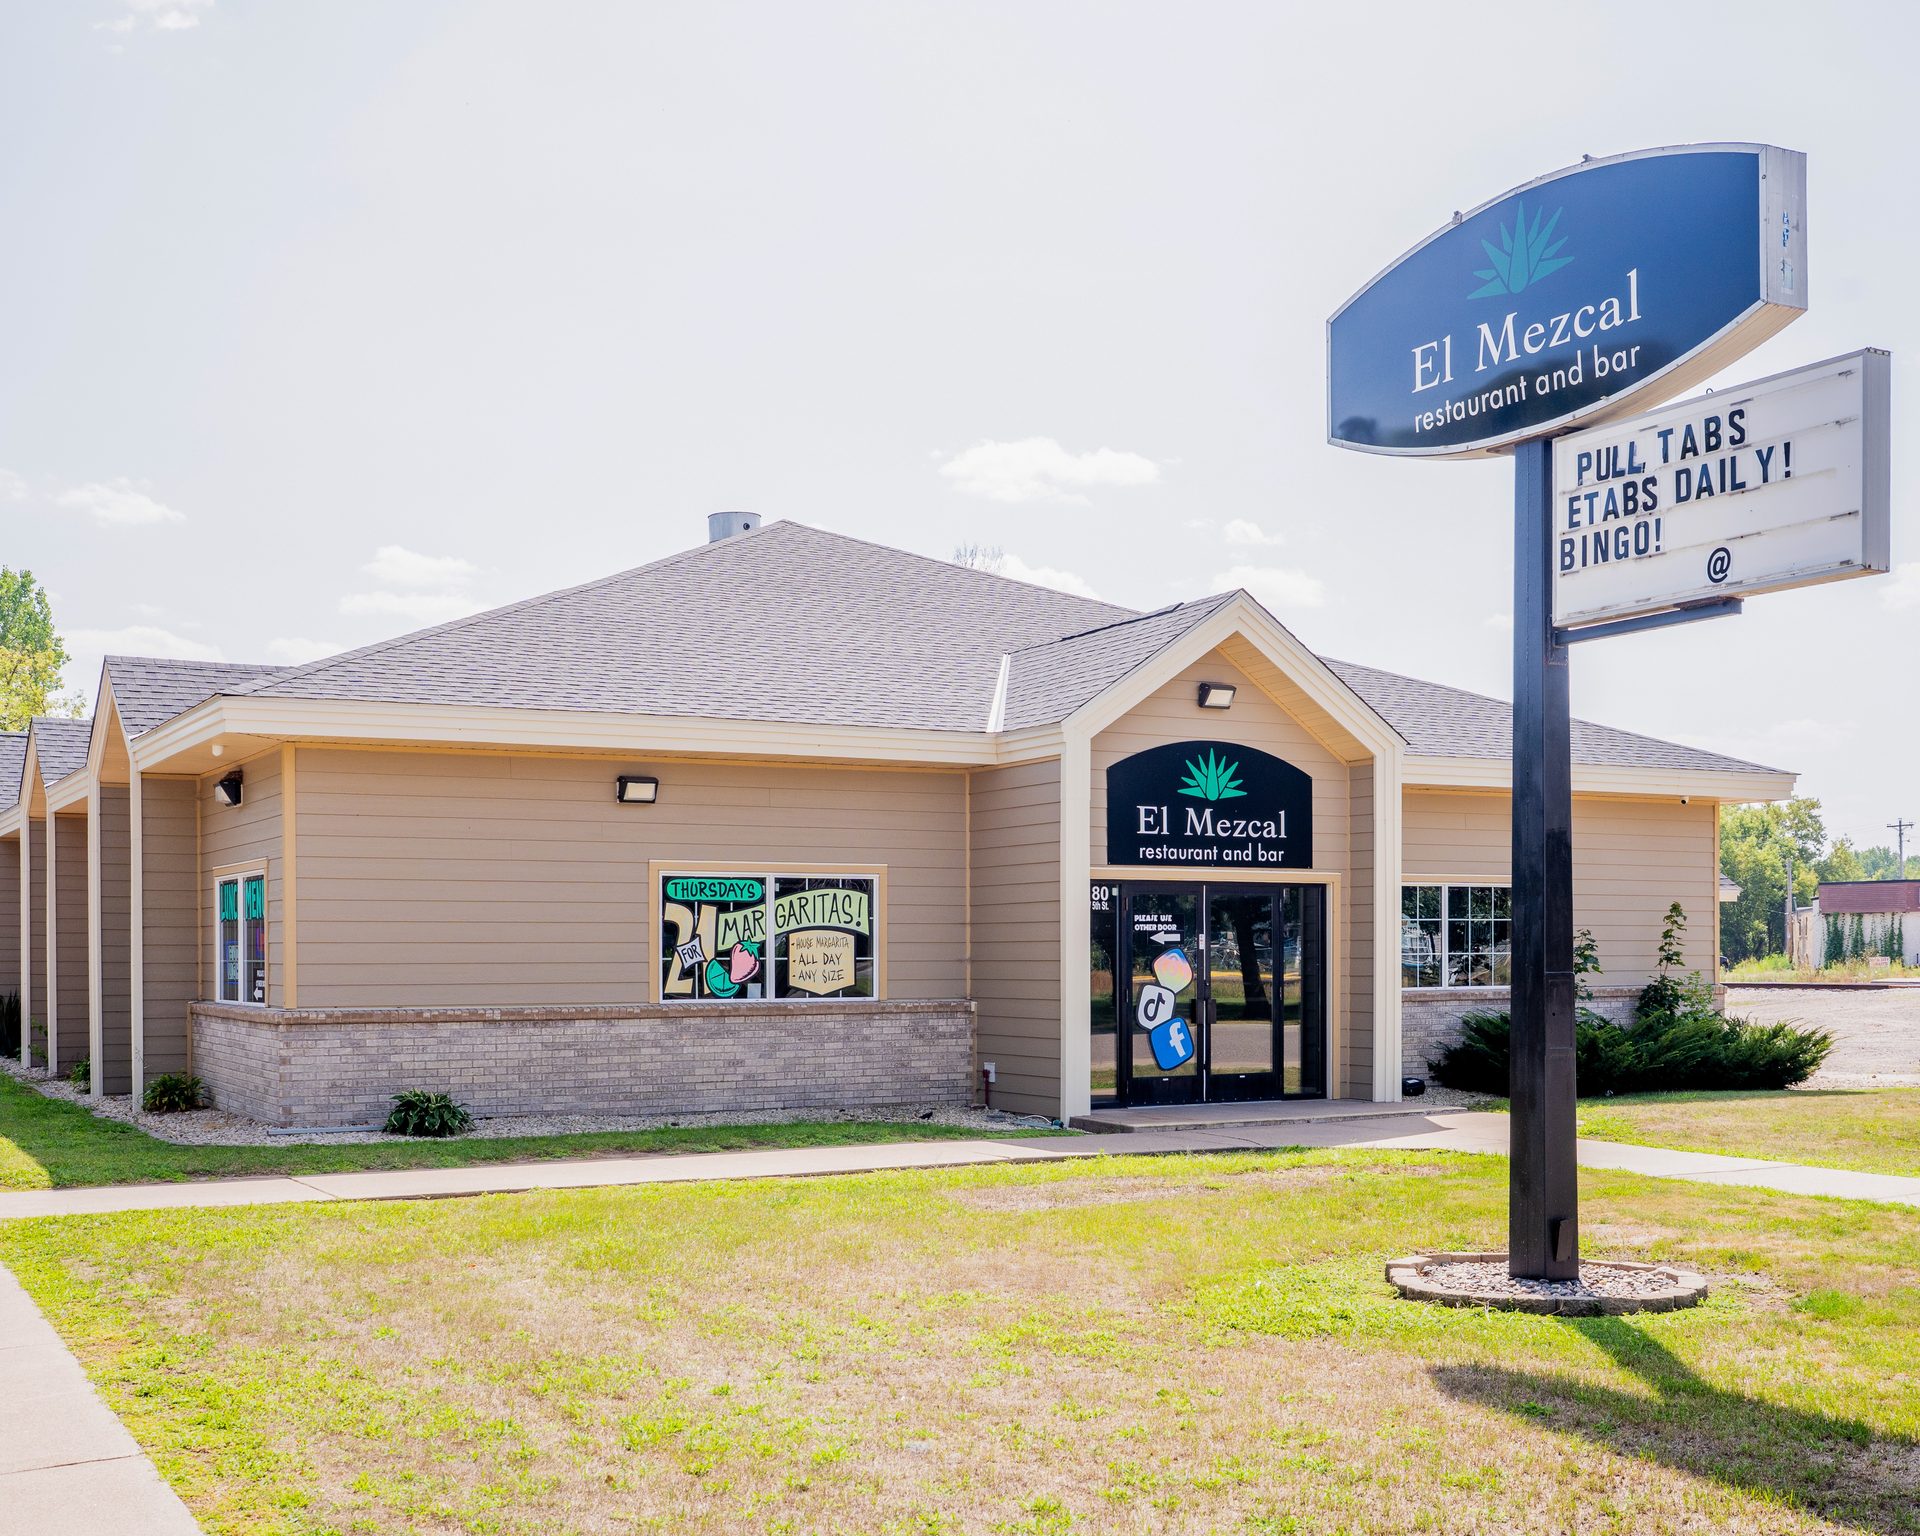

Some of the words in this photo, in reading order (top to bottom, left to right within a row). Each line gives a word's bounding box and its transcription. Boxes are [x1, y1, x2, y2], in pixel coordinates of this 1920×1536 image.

[1411, 334, 1454, 394] El
[1474, 269, 1642, 372] Mezcal
[1415, 375, 1527, 432] restaurant
[1535, 350, 1582, 395] and
[1593, 344, 1641, 379] bar
[1657, 409, 1746, 464] TABS
[1568, 476, 1658, 529] ETABS
[1675, 441, 1791, 504] DAILY!
[1560, 518, 1661, 571] BINGO!
[1706, 546, 1732, 583] @
[1136, 805, 1170, 835] El
[1184, 807, 1287, 839] Mezcal
[1139, 844, 1218, 861] restaurant
[1223, 843, 1252, 861] and
[1258, 843, 1284, 862] bar
[671, 881, 755, 899] THURSDAYS
[1134, 914, 1158, 922] PLEASE
[1160, 914, 1173, 922] USE
[681, 944, 702, 964] FOR
[796, 938, 814, 949] HOUSE
[816, 936, 849, 949] MARGARITA
[798, 952, 817, 966] ALL
[823, 952, 842, 965] DAY
[798, 969, 817, 982] ANY
[822, 969, 844, 984] SIZE
